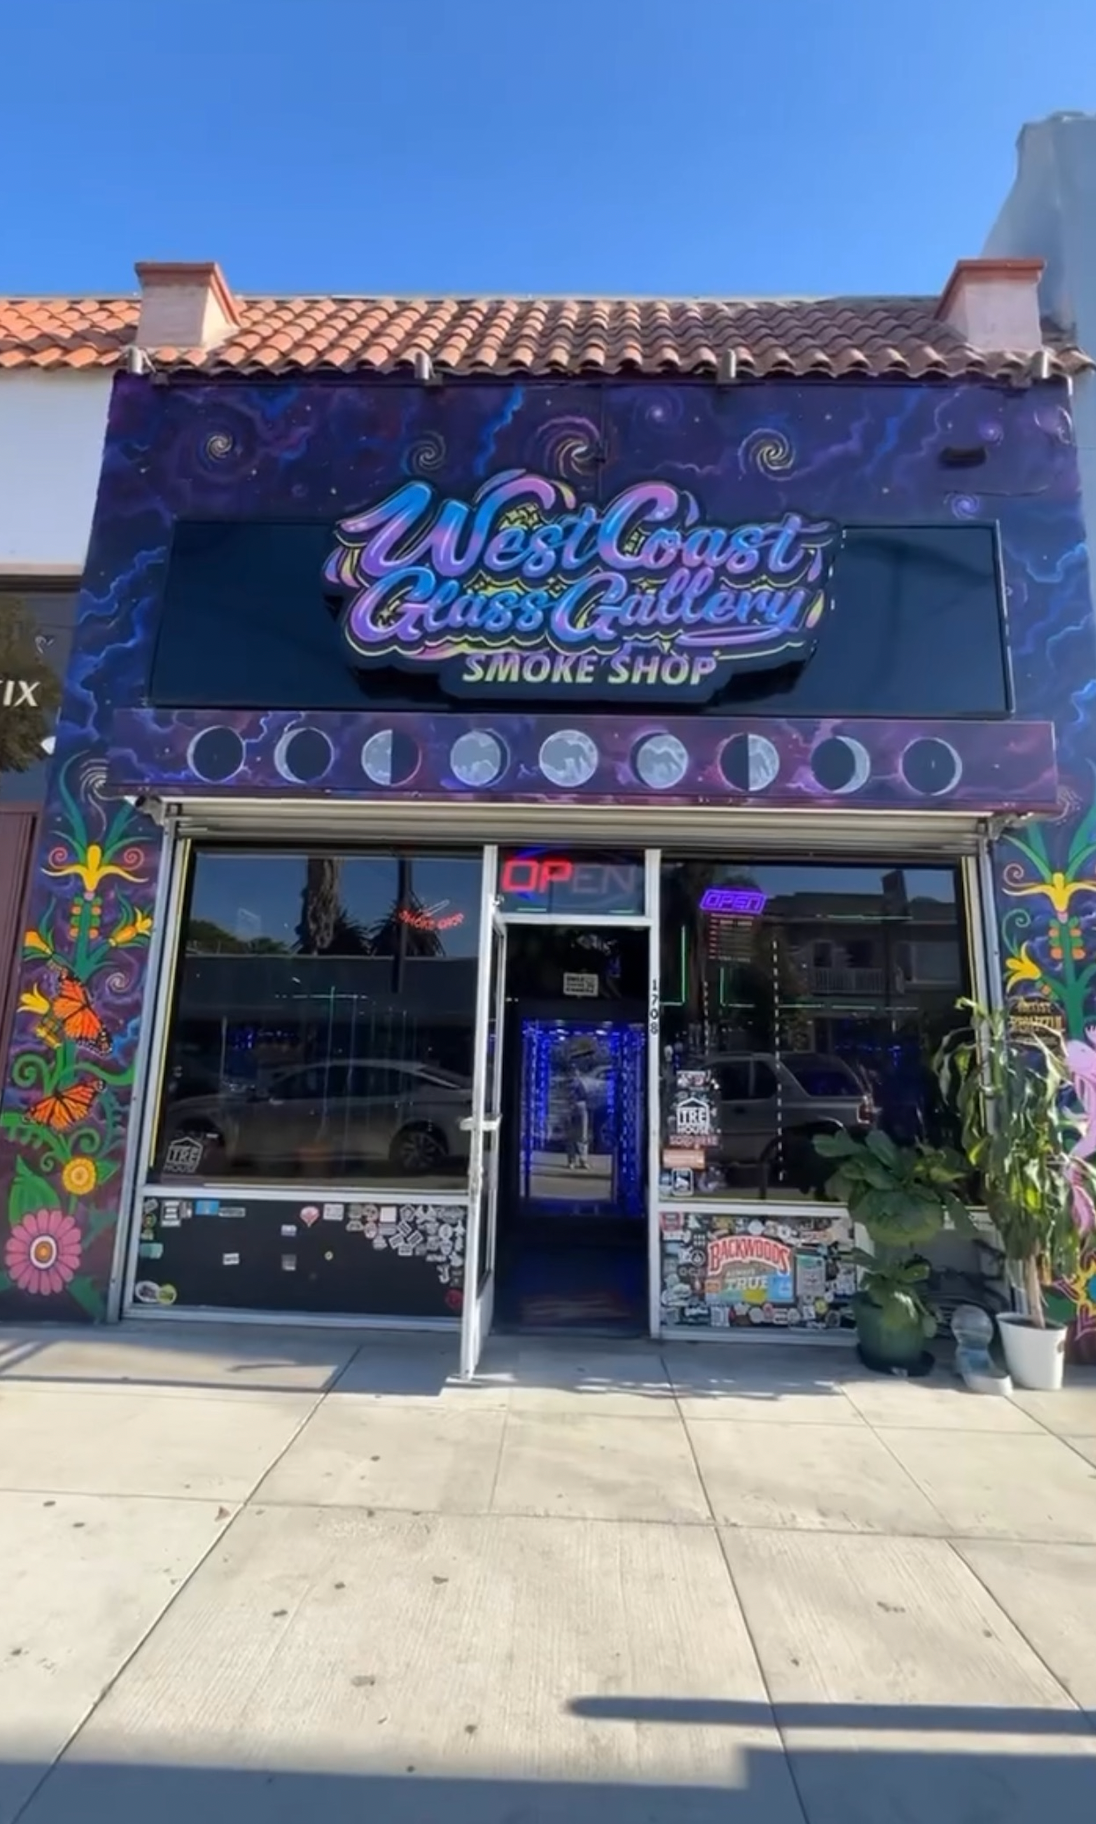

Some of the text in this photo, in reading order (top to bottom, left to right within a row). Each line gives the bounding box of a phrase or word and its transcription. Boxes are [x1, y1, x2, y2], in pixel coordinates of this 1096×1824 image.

[336, 471, 832, 577] West Coast
[349, 566, 809, 645] Glass Gallery
[463, 653, 717, 686] SMOKE SHOP
[502, 859, 638, 893] OPEN
[705, 894, 761, 910] OPEN
[650, 979, 659, 1035] 1708
[707, 1236, 791, 1277] BACKWOODS
[725, 1276, 768, 1291] TRUE
